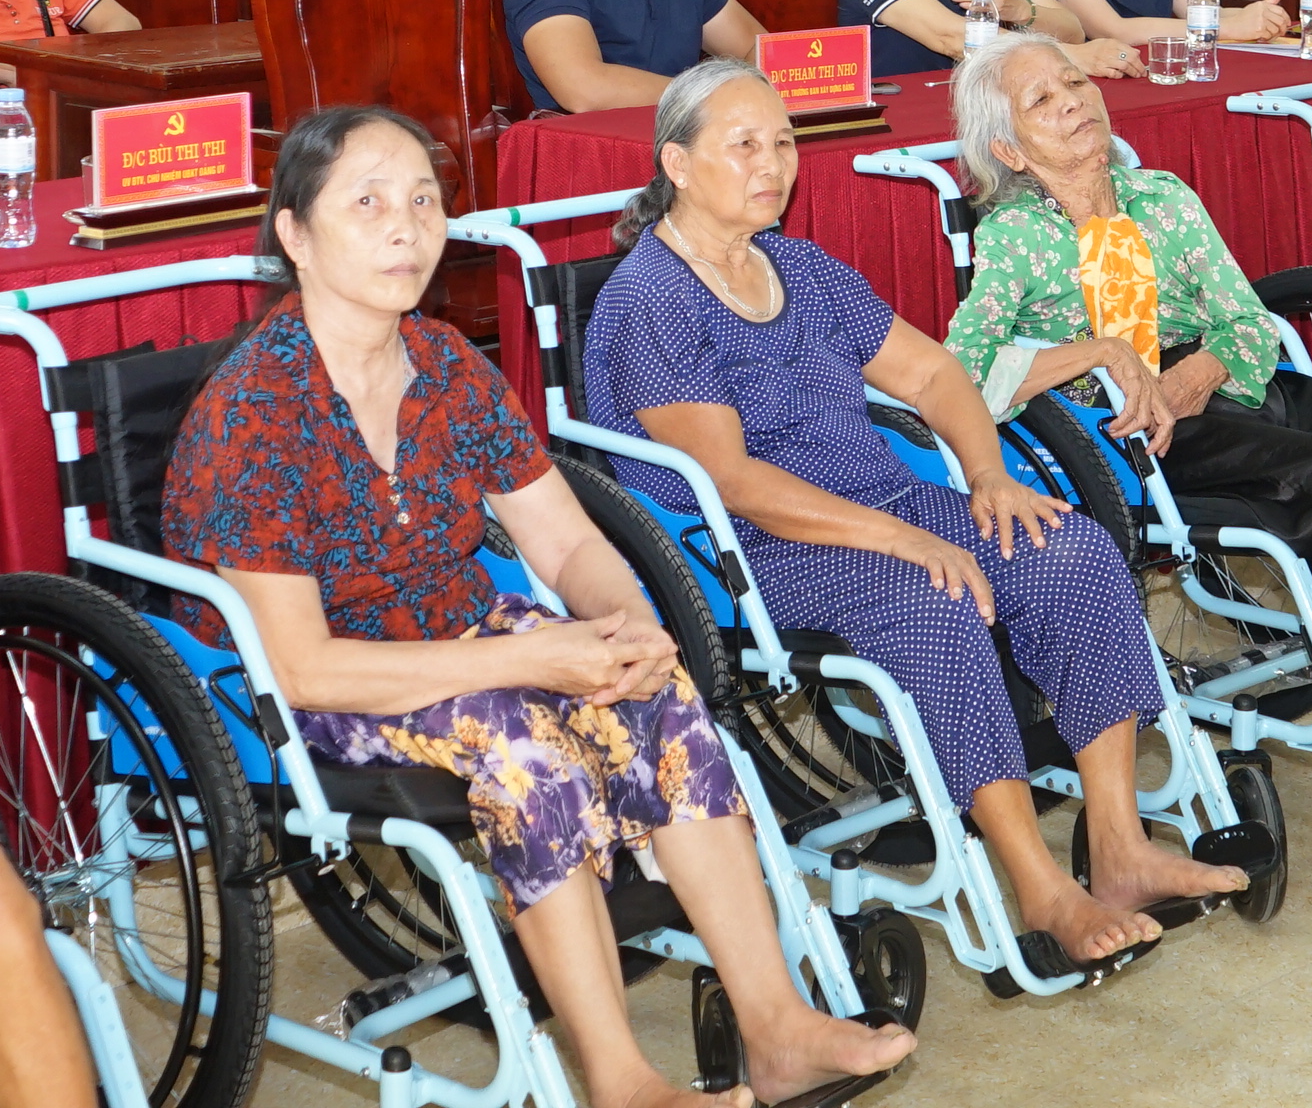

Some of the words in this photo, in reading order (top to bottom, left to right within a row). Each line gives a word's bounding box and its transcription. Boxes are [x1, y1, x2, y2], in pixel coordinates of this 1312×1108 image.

[789, 67, 816, 83] PHẠM
[818, 65, 835, 81] THỊ
[837, 63, 857, 77] NHO
[810, 87, 819, 95] BAN
[122, 150, 146, 169] Đ/C
[149, 143, 172, 165] BÙI
[176, 143, 199, 163] THỊ
[202, 140, 225, 157] THI
[147, 170, 160, 183] CHỦ
[161, 170, 181, 182] NHIỆM
[199, 163, 216, 176] ĐẢNG
